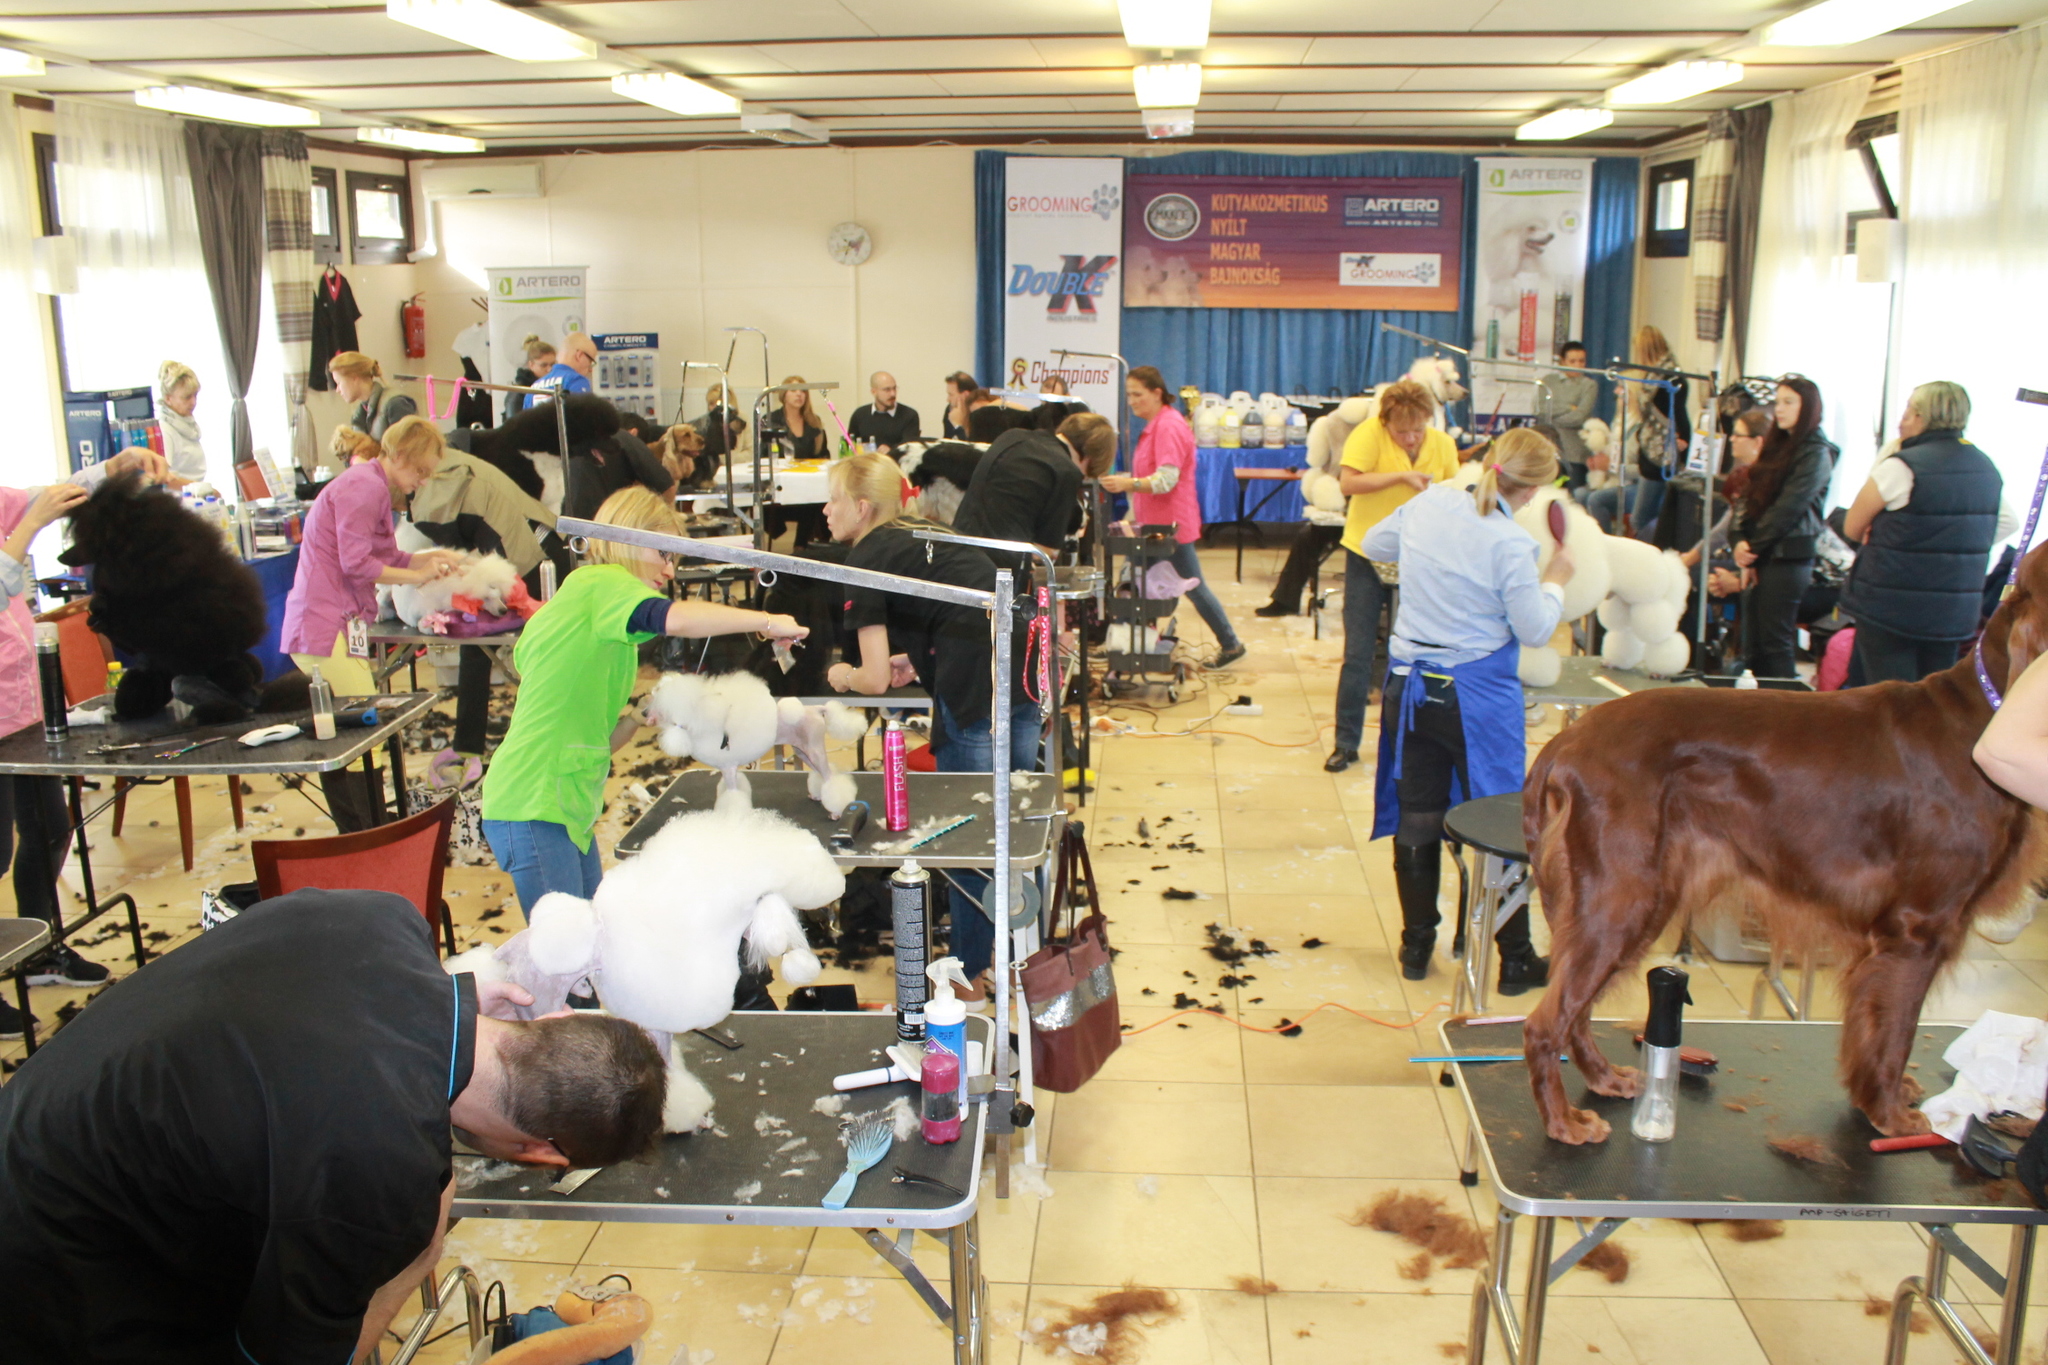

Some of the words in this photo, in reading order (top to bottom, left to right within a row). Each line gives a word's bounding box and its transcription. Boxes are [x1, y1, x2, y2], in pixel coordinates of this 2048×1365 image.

[1509, 169, 1583, 180] ARTERO
[1007, 196, 1093, 212] GROOMING
[1211, 193, 1329, 213] KUTYAKOZMETIKUS
[1364, 198, 1440, 213] ARTERO
[1210, 212, 1248, 236] NYÍLT
[1210, 242, 1261, 261] MAGYAR
[516, 275, 581, 288] ARTERO
[1209, 262, 1281, 286] BAJNOKSÁG
[1350, 269, 1415, 279] GROOMING
[603, 335, 647, 344] ARTERO
[351, 635, 365, 648] 10
[893, 755, 905, 792] FLASH
